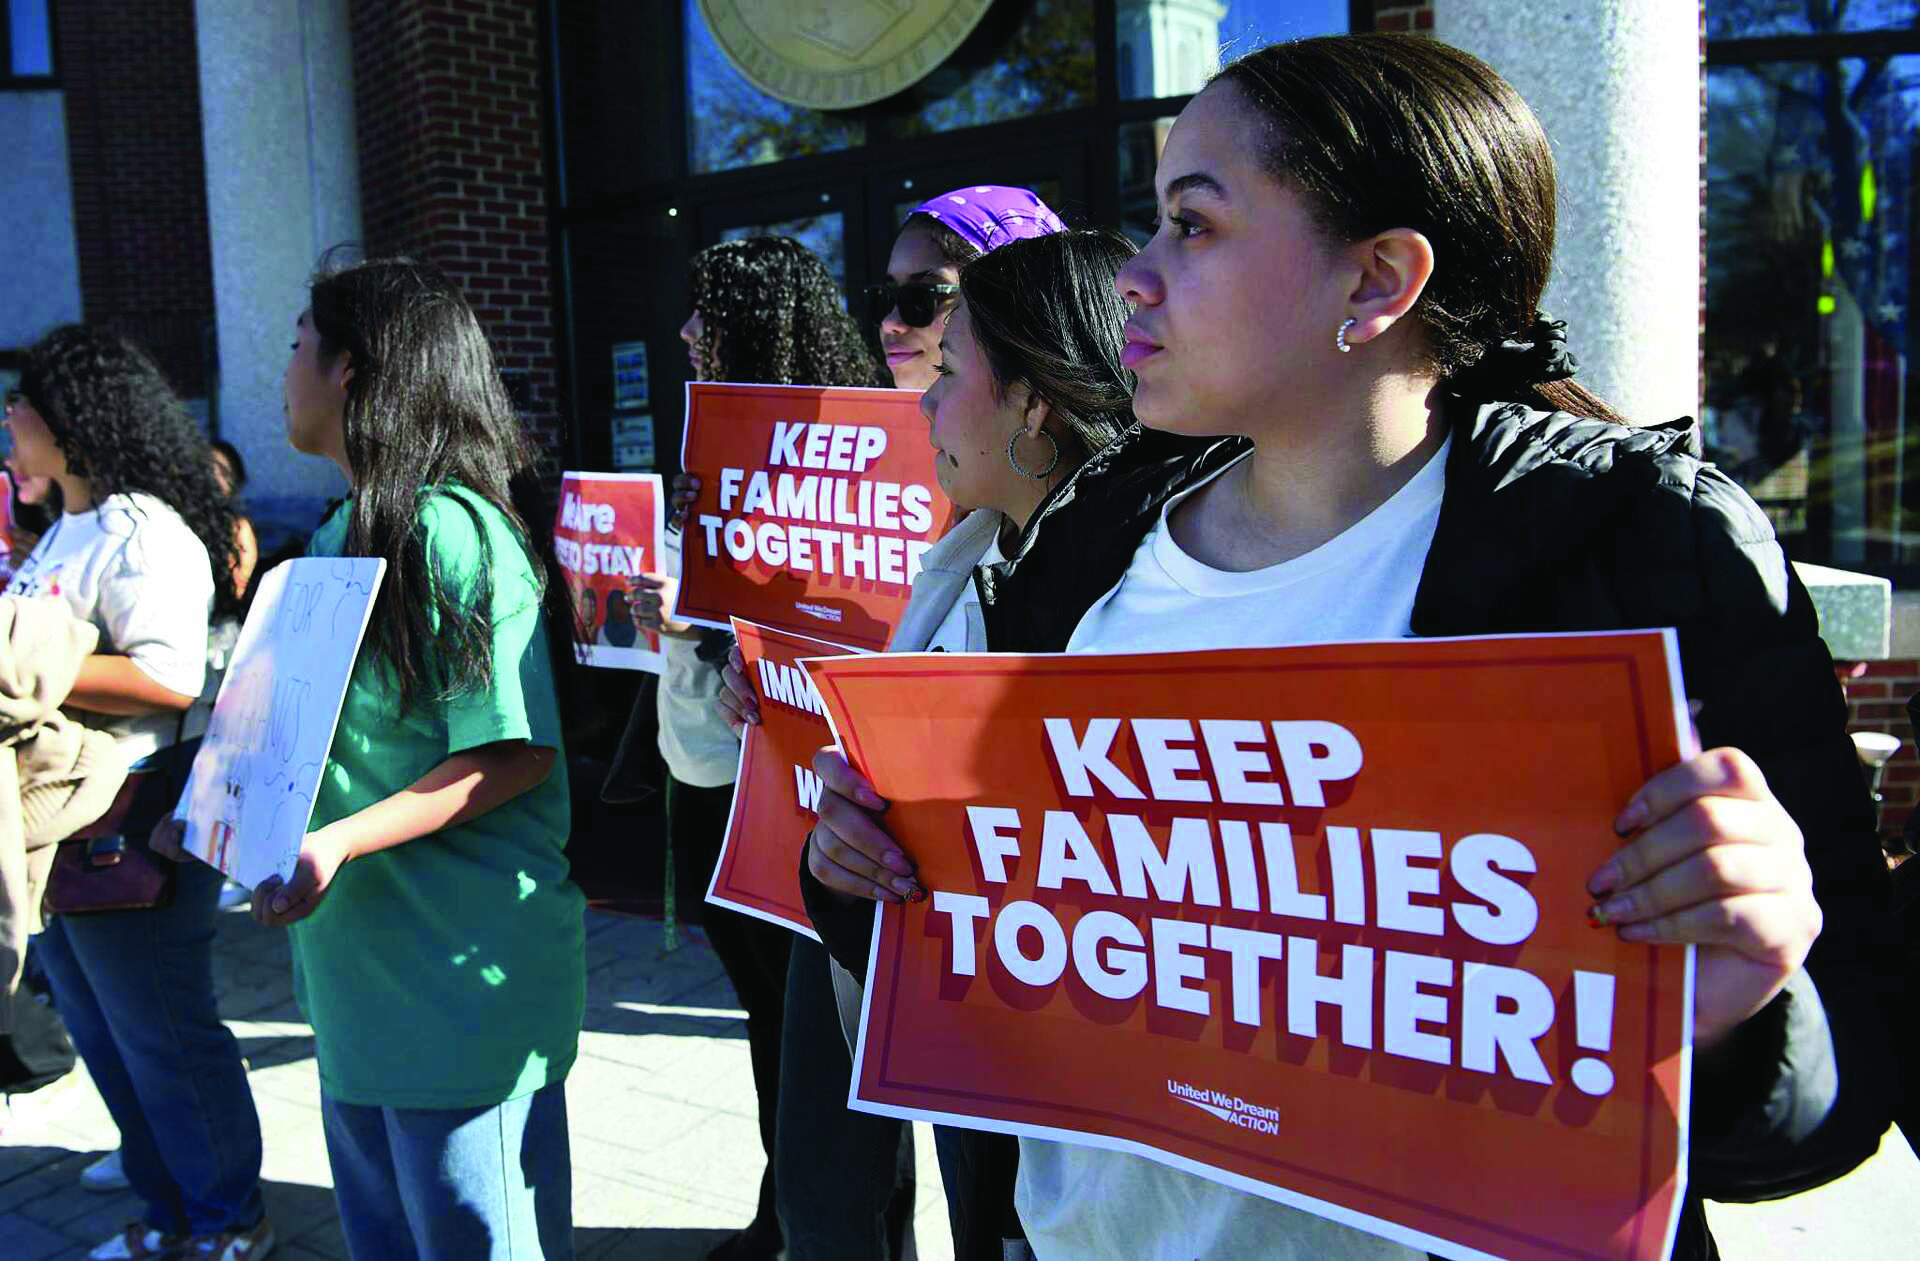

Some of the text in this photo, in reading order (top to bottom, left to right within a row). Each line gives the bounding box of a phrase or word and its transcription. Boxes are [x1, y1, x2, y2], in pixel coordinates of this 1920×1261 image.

[769, 421, 888, 473] KEEP
[720, 467, 934, 533] FAMILIES
[583, 542, 645, 577] STAY
[1043, 718, 1363, 807] KEEP
[966, 805, 1538, 945] FAMILIES
[933, 890, 1615, 1095] TOGETHER!
[1167, 1079, 1279, 1121] United We Dream
[1228, 1111, 1279, 1135] ACTION
